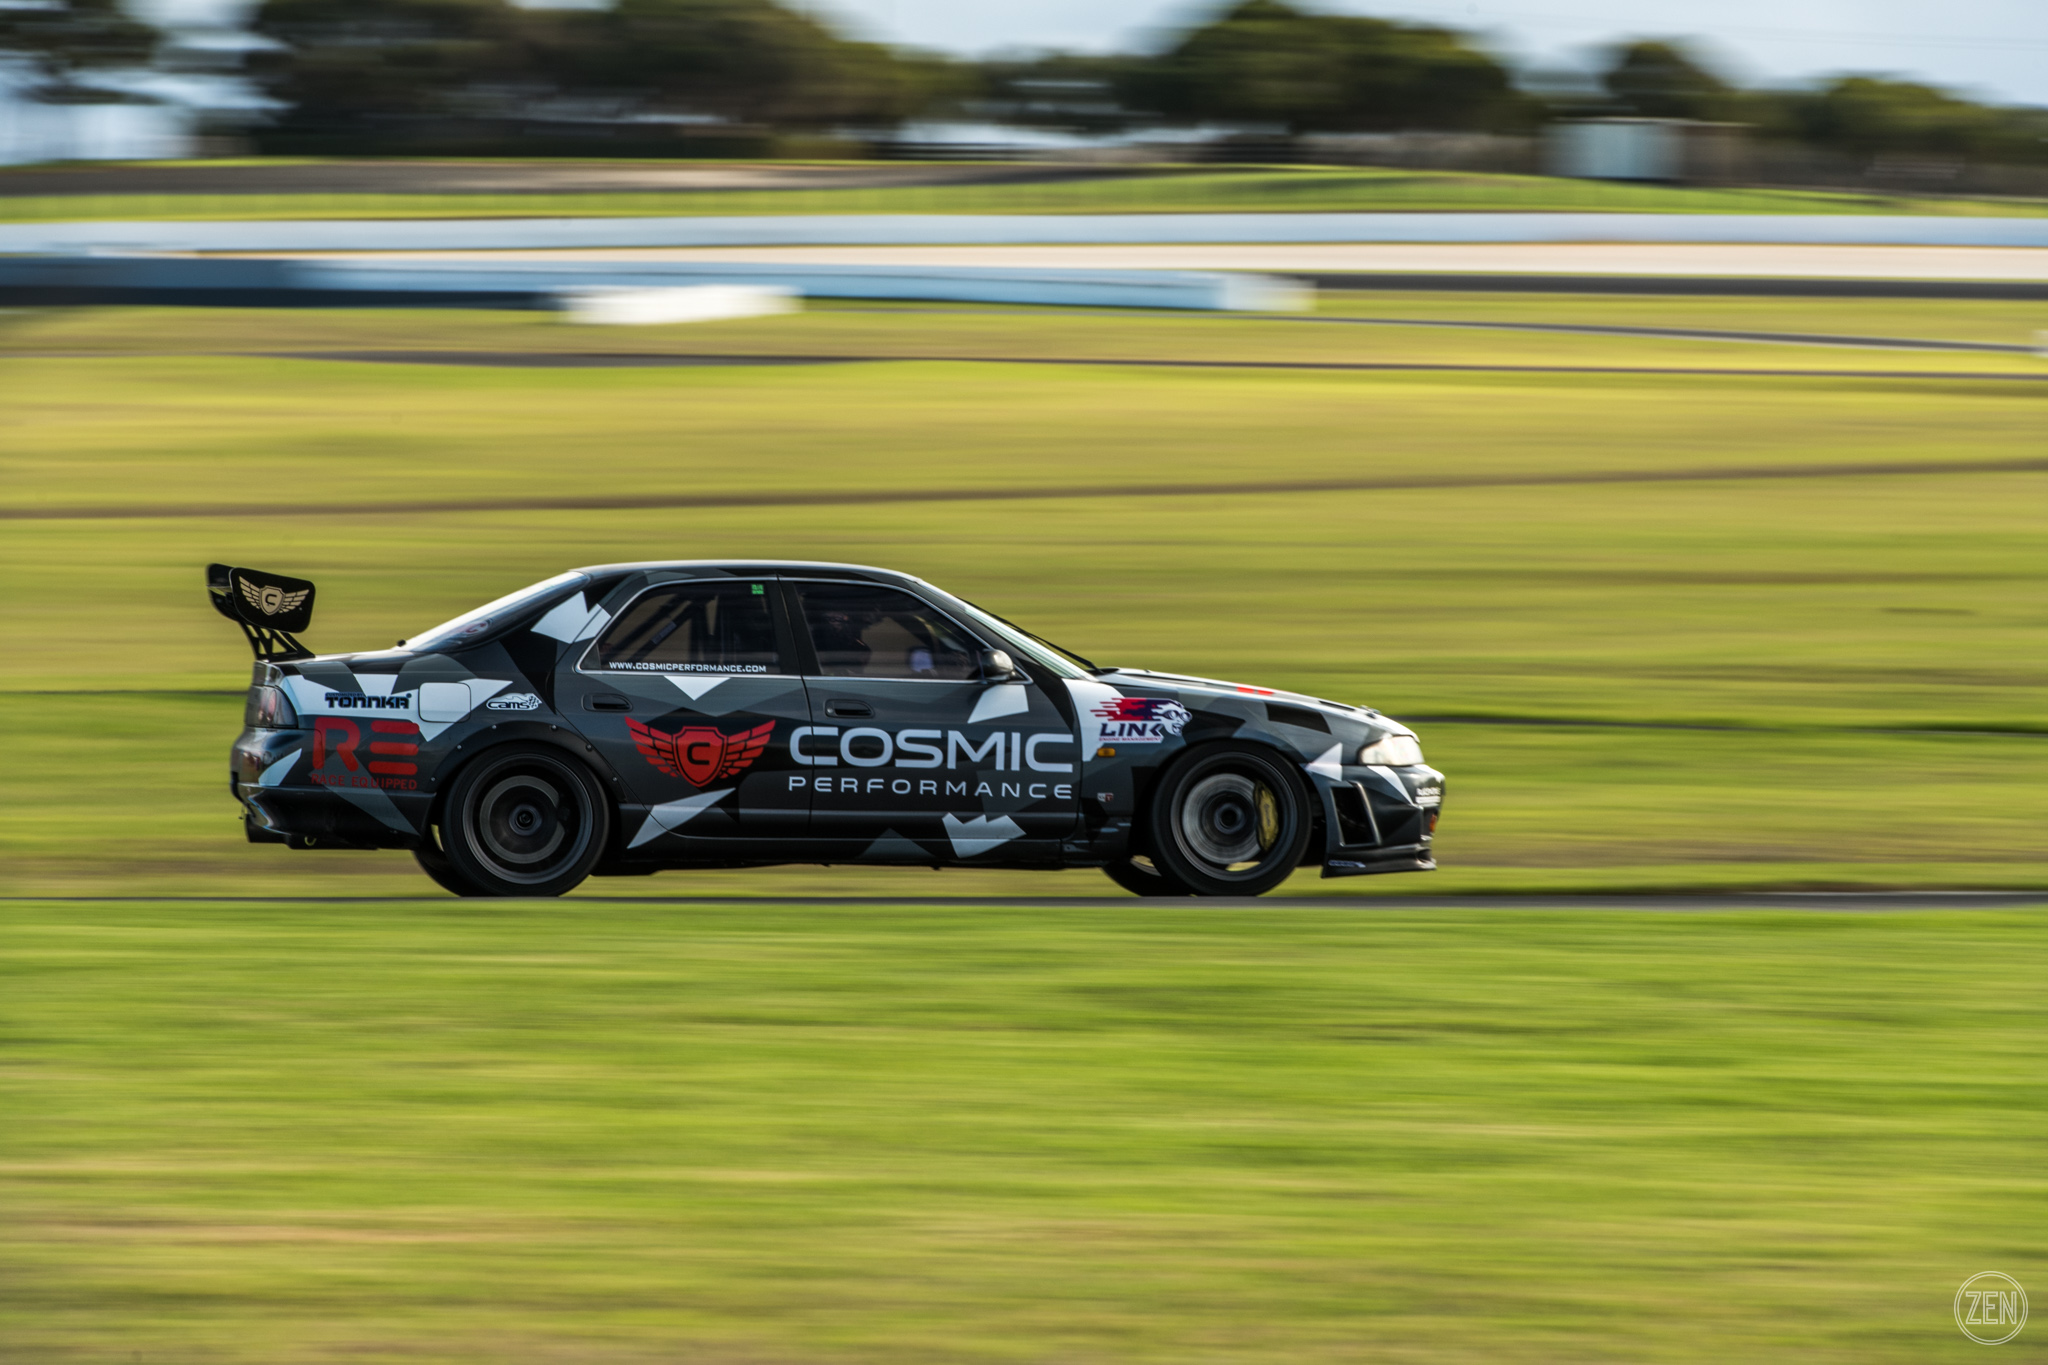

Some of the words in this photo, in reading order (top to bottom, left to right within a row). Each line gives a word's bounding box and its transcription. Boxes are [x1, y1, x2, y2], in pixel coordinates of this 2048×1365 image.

[608, 661, 767, 673] WWW.COSMICPERFORMANCE.COM
[1100, 722, 1163, 737] LINK
[686, 741, 711, 766] C
[789, 725, 1075, 773] COSMIC
[311, 773, 346, 787] RACE
[351, 776, 418, 791] EQUIPPED
[788, 775, 1073, 800] PERFORMANCE
